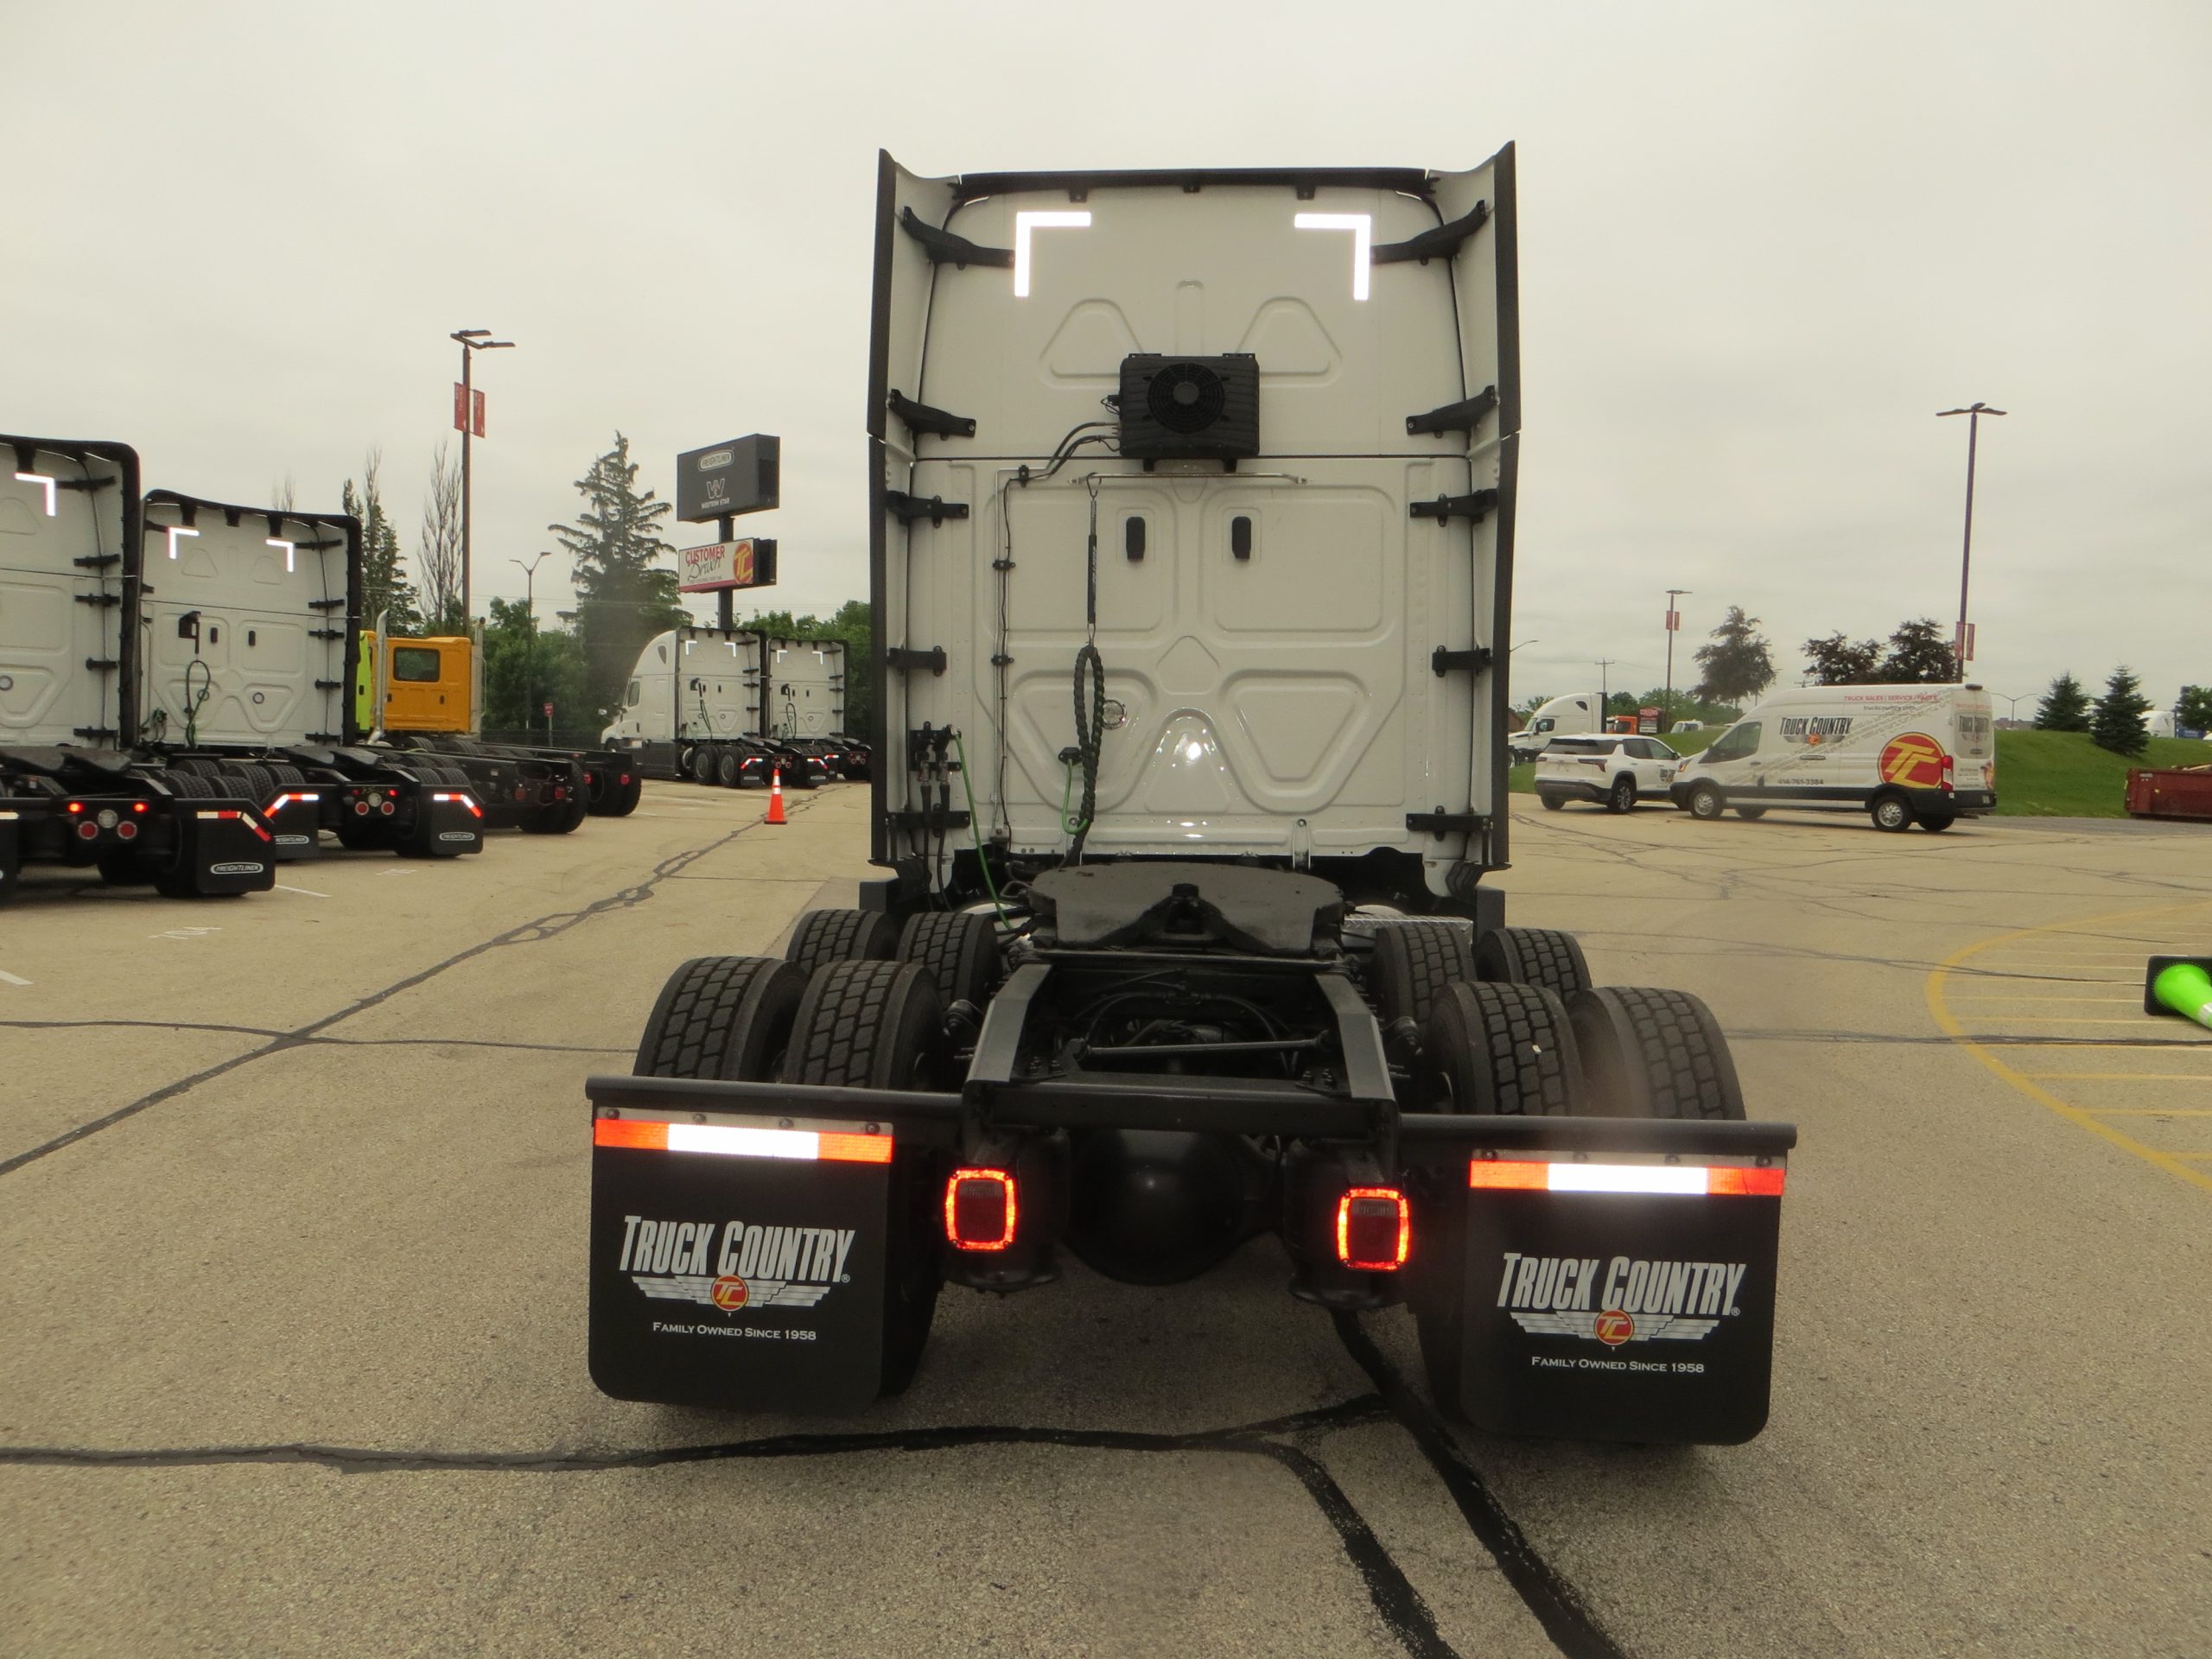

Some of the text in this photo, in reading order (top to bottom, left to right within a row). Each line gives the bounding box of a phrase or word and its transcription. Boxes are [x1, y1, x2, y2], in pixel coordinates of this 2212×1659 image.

[685, 545, 725, 564] CUSTOMER
[1779, 716, 1853, 735] TRUCK COUNTRY
[619, 1215, 855, 1283] TRUCK COUNTRY
[1497, 1252, 1746, 1316] TRUCK COUNTRY
[652, 1322, 817, 1341] FAMILY OWNED SINCE 1958
[1531, 1357, 1705, 1374] FAMILY OWNED SINCE 1958
